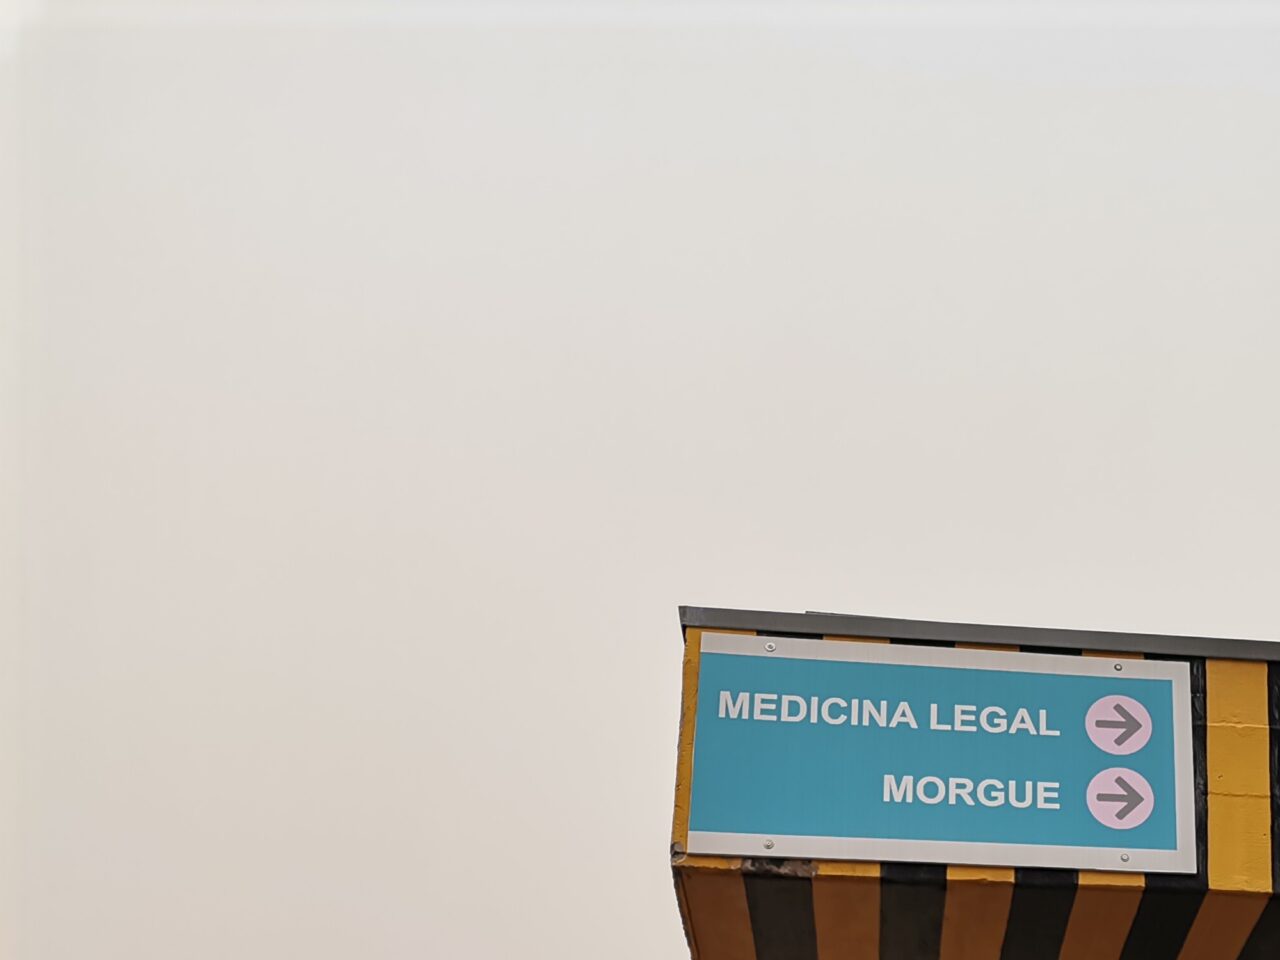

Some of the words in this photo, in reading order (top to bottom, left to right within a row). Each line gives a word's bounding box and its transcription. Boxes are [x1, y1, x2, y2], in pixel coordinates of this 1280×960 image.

[718, 690, 918, 729] MEDICINA
[929, 703, 1061, 736] LEGAL
[882, 774, 1061, 809] MORGUE
